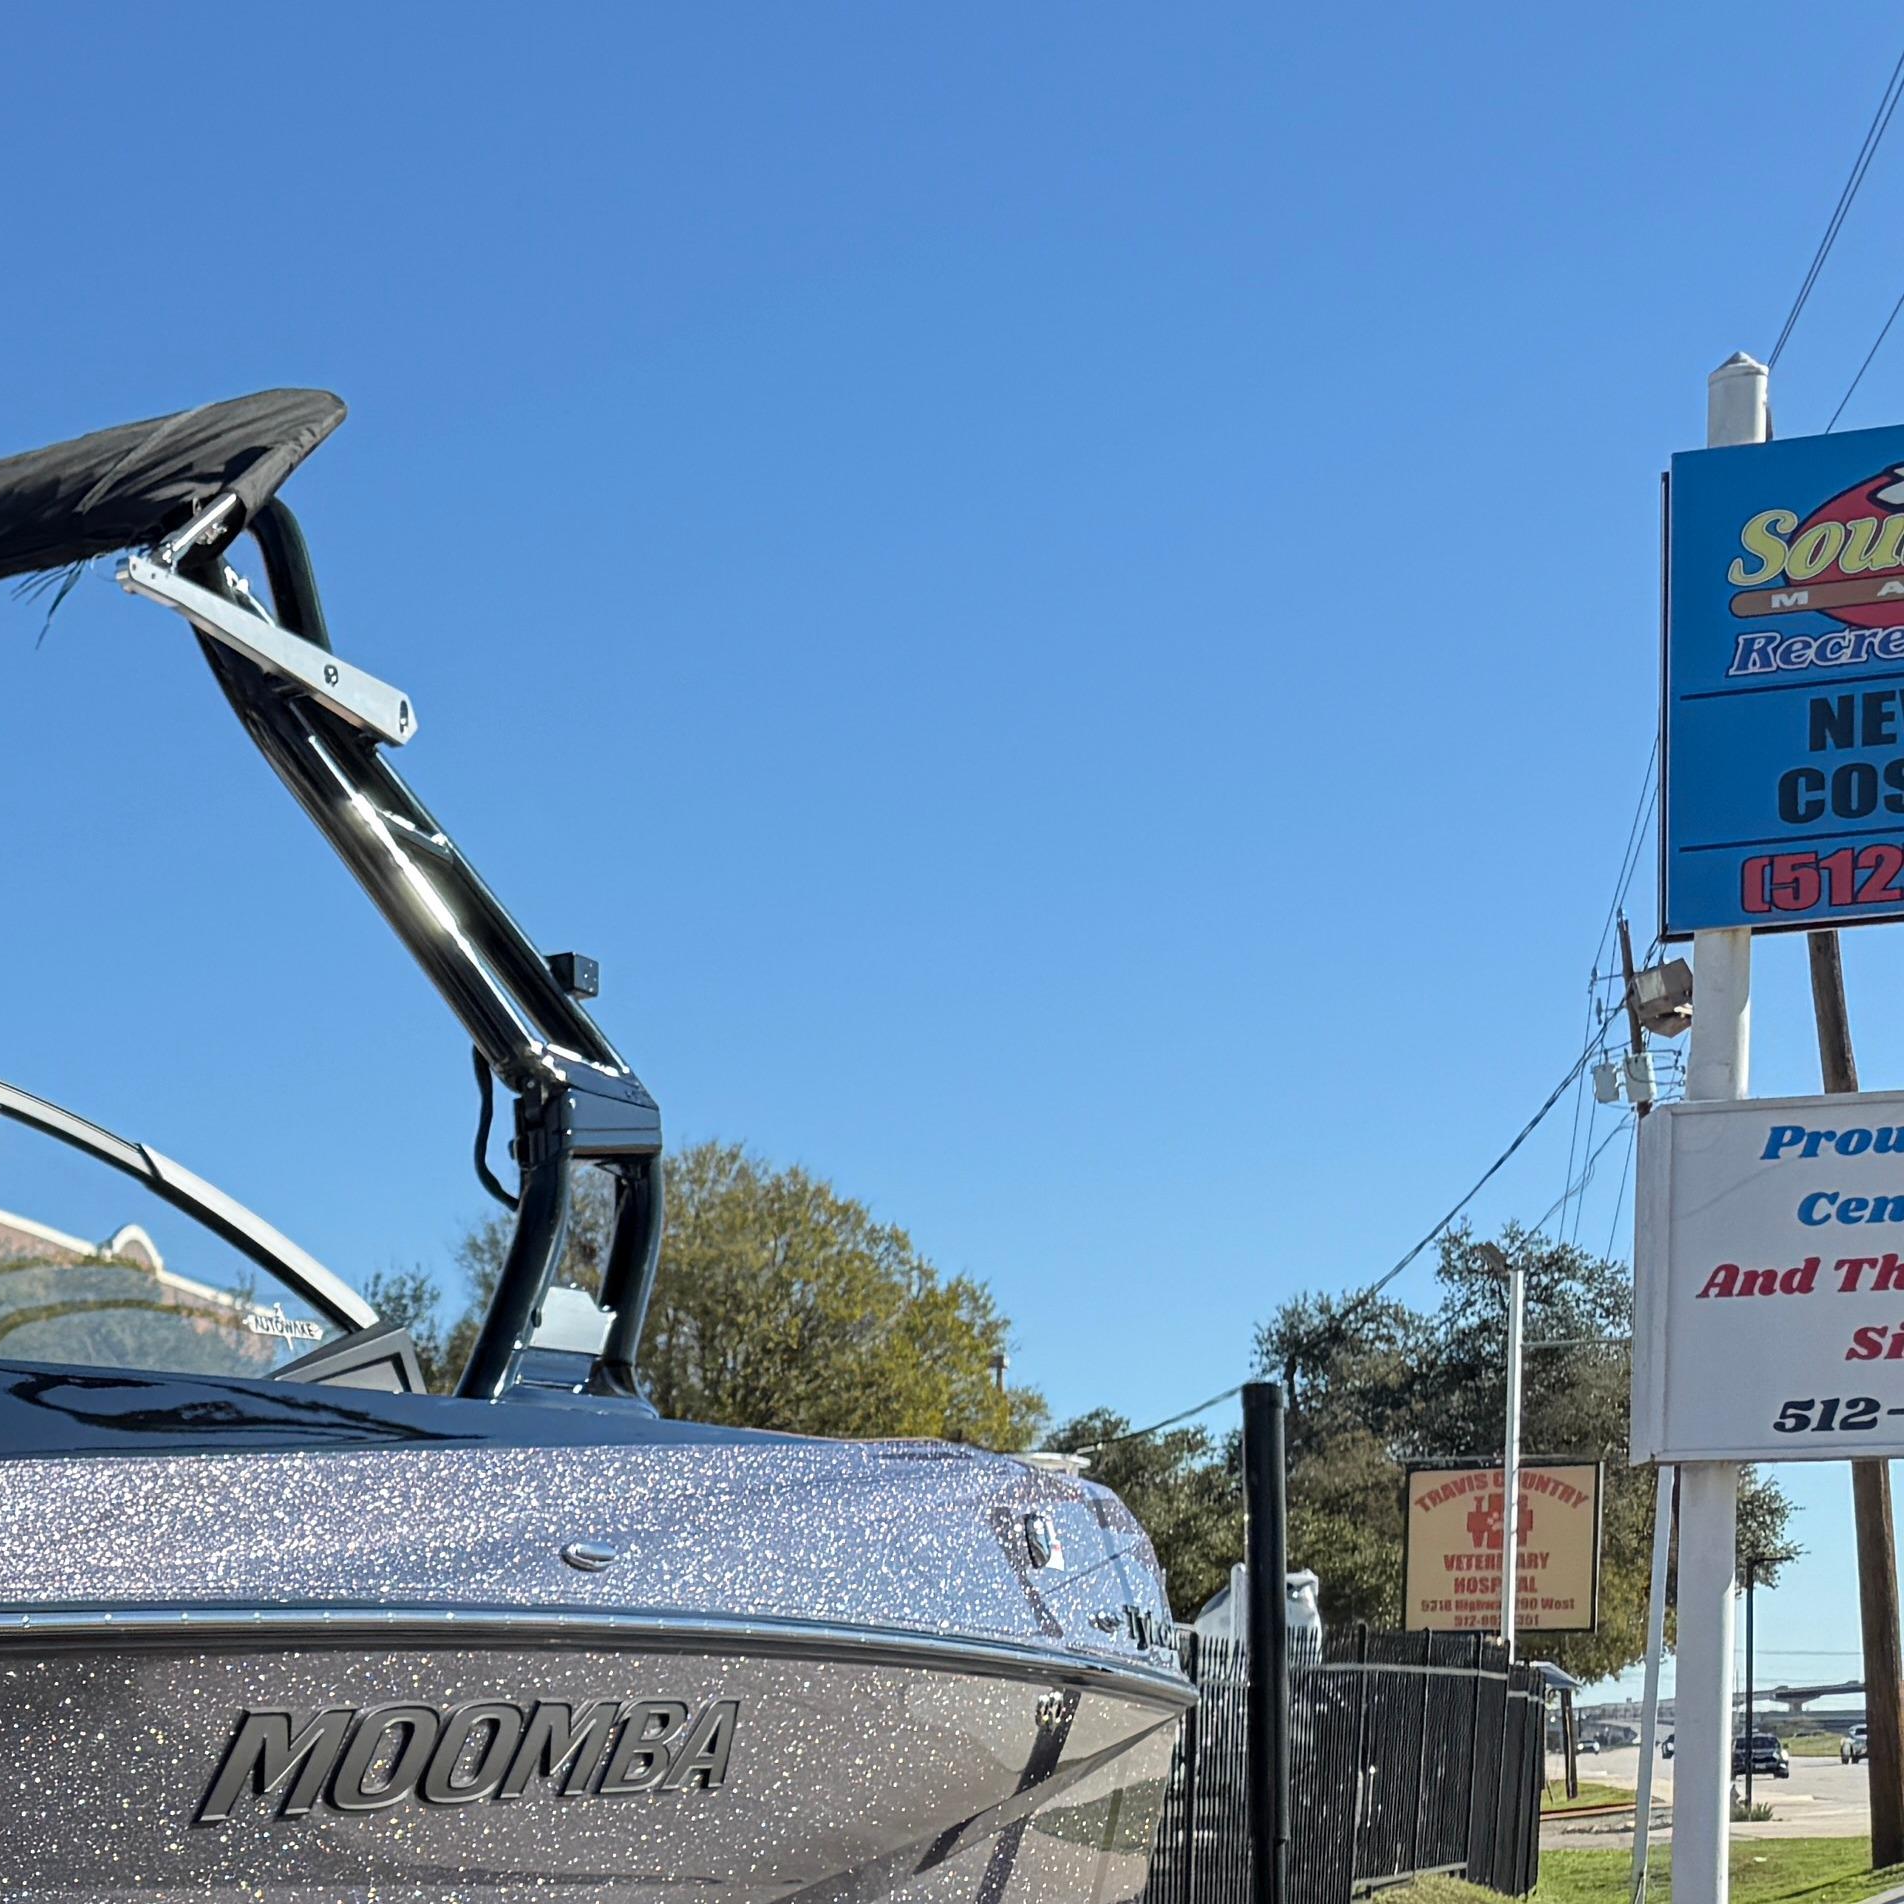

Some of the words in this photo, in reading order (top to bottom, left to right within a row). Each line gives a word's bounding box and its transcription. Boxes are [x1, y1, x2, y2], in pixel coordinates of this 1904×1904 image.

[1727, 508, 1904, 587] Sou
[1726, 626, 1904, 678] Recre
[1808, 689, 1904, 753] NE
[1740, 844, 1904, 915] (512
[1796, 1190, 1904, 1227] Cen
[1695, 1256, 1818, 1299] And
[1835, 1251, 1904, 1293] Th
[254, 1314, 316, 1337] AUTOWAKE
[1845, 1321, 1904, 1362] Si
[1414, 1472, 1488, 1513] TRAVIS
[1493, 1471, 1589, 1509] CUNTRY
[1443, 1552, 1550, 1571] VETERIARY
[1453, 1575, 1538, 1595] HOSPAL
[1455, 1599, 1502, 1613] Highwa
[1540, 1597, 1575, 1610] West
[192, 1697, 741, 1829] MOOMBA
